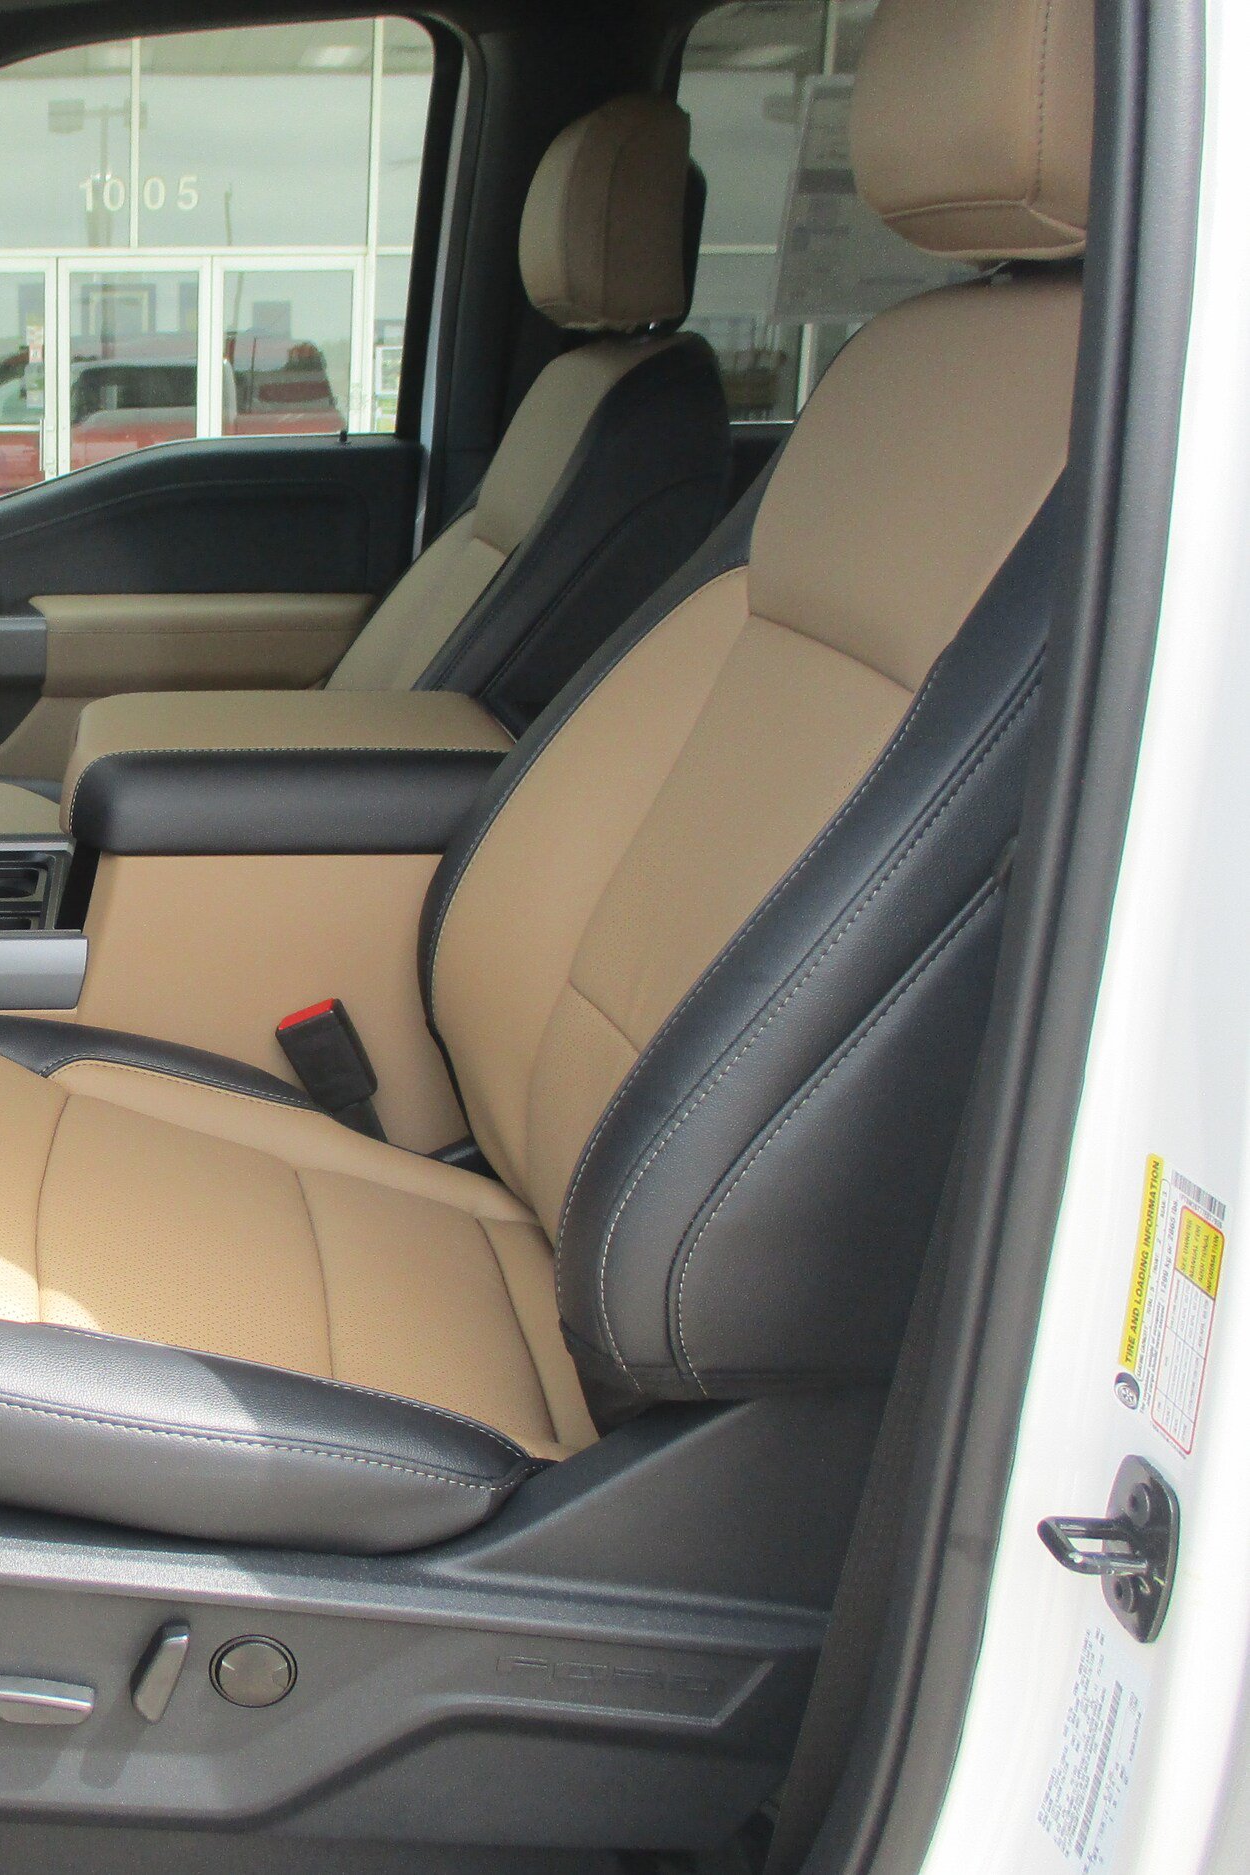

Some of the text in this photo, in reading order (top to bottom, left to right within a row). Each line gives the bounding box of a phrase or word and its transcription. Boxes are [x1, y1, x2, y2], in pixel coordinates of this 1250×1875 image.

[79, 173, 199, 212] 1005
[1125, 1160, 1160, 1363] TIRE AND LOADING INFORMATION
[1206, 1234, 1220, 1292] INFORMATION
